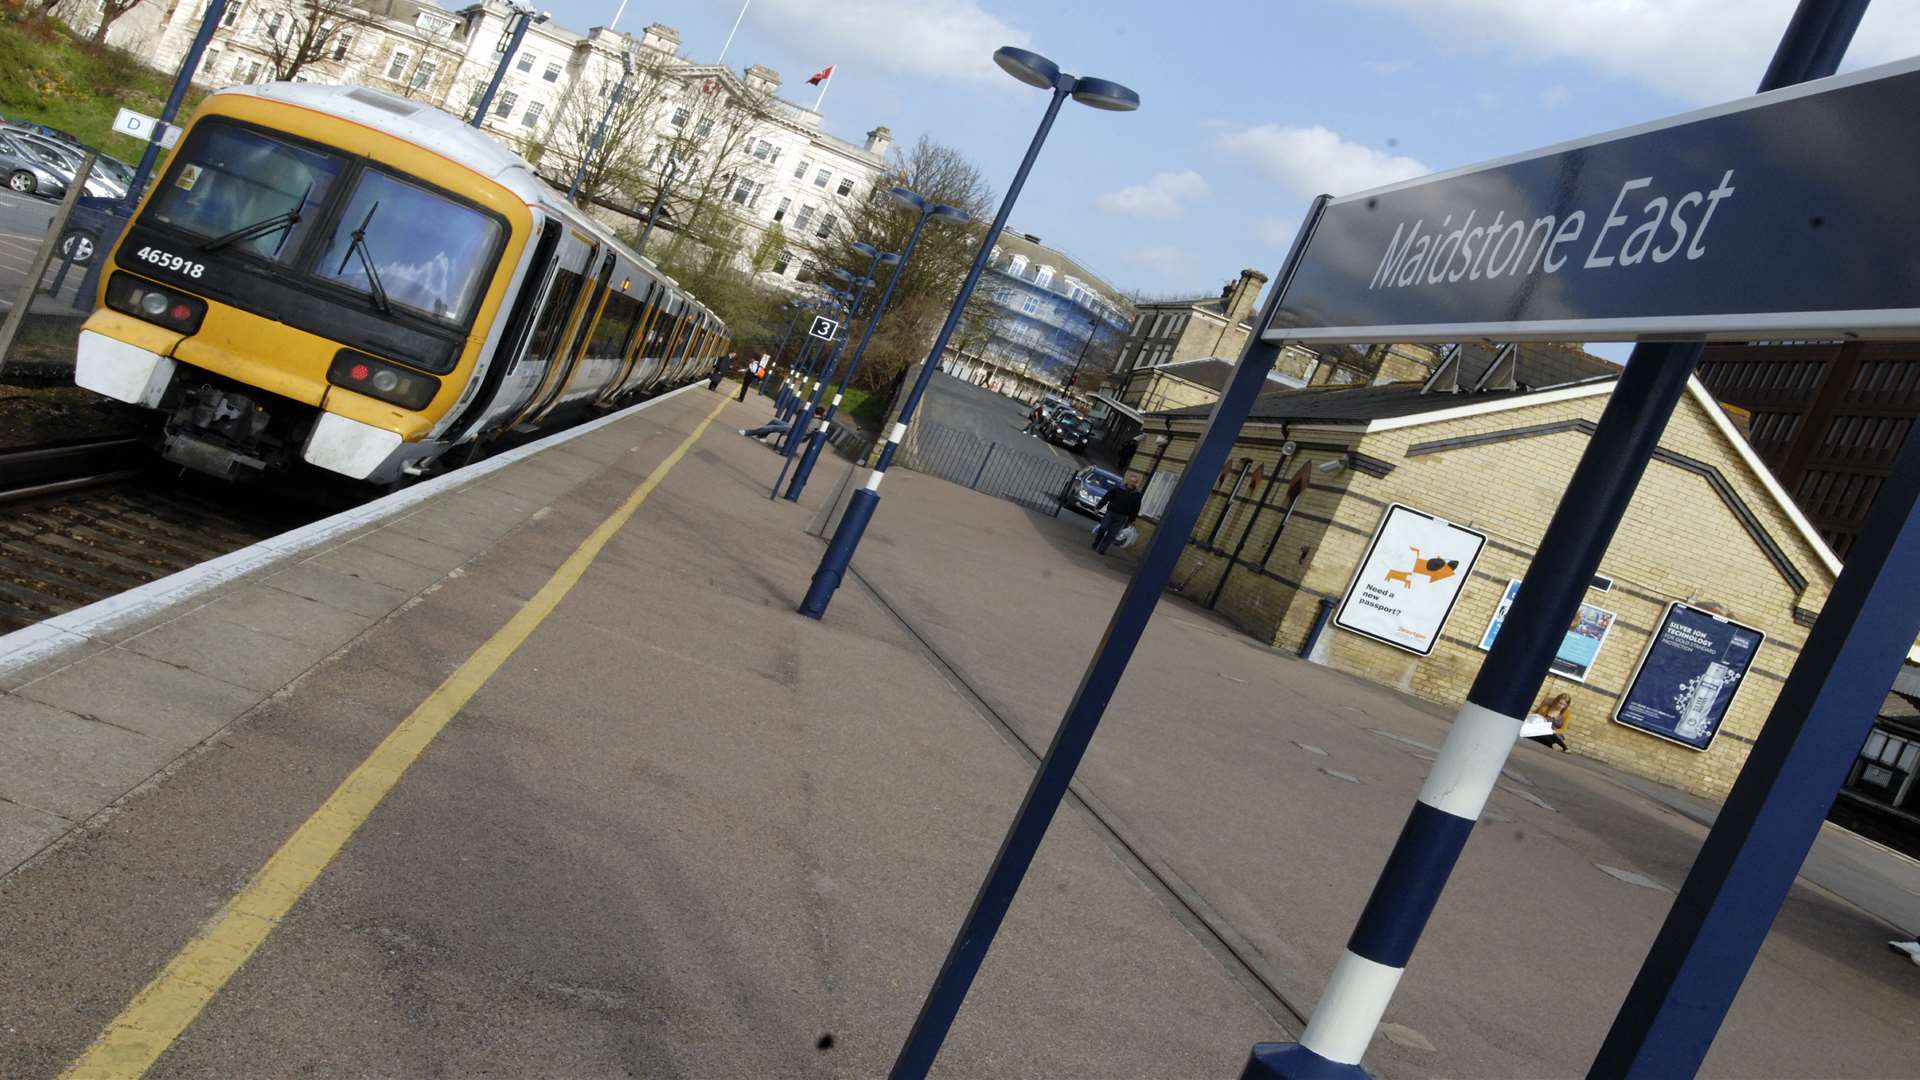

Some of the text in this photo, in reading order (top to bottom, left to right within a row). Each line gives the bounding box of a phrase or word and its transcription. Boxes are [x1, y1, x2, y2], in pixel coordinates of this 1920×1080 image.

[128, 117, 141, 130] D
[1368, 169, 1736, 290] Maidstone East
[137, 246, 205, 278] 465918
[817, 321, 831, 335] 3
[1362, 591, 1379, 601] new
[1366, 584, 1388, 596] Need
[1359, 598, 1402, 616] passport?
[1667, 628, 1713, 647] TECHNOLOGY
[1669, 622, 1707, 639] SILVER ION
[1664, 633, 1675, 641] FOR
[1675, 637, 1690, 646] GOLD
